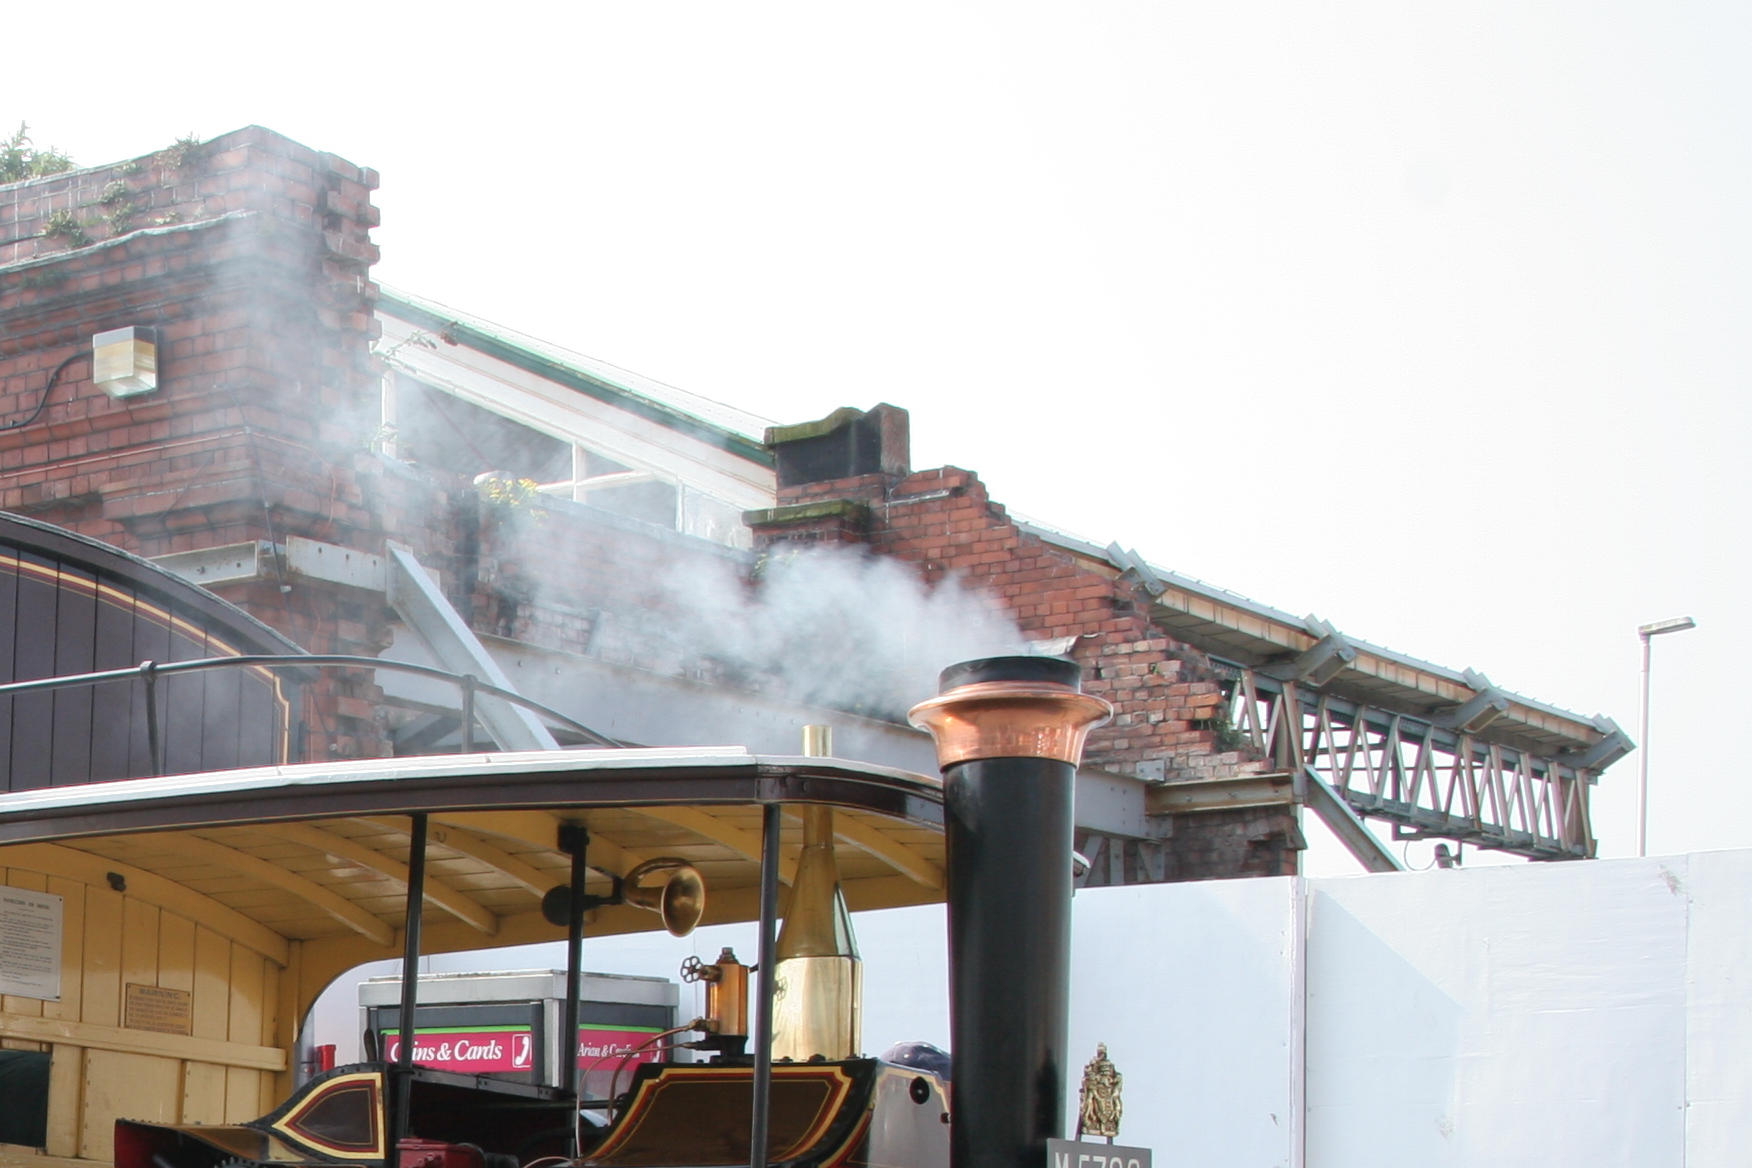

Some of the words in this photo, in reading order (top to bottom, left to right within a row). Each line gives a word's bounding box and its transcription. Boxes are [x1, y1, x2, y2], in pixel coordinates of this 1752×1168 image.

[390, 1040, 436, 1063] Cins
[437, 1042, 451, 1061] &
[454, 1040, 503, 1061] Cards
